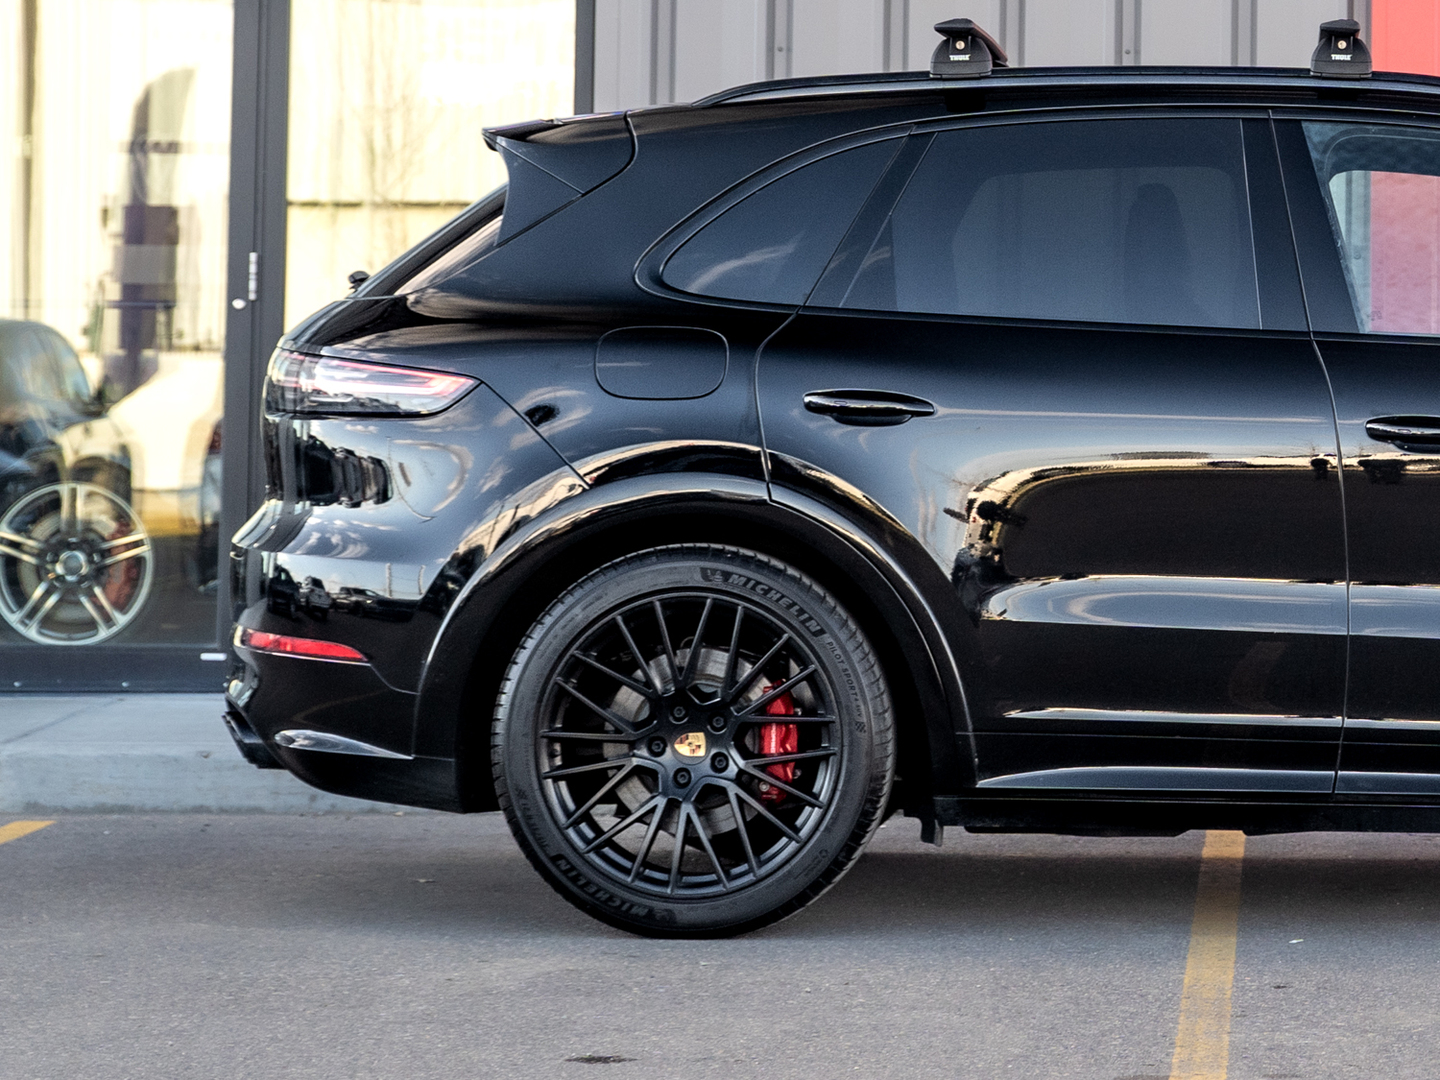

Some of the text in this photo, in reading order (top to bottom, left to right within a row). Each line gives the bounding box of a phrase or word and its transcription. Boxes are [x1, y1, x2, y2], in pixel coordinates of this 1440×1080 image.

[728, 574, 821, 634] MICHELIN
[826, 641, 845, 664] PILOT
[842, 668, 858, 696] SPORT
[557, 860, 650, 916] MICHELIN
